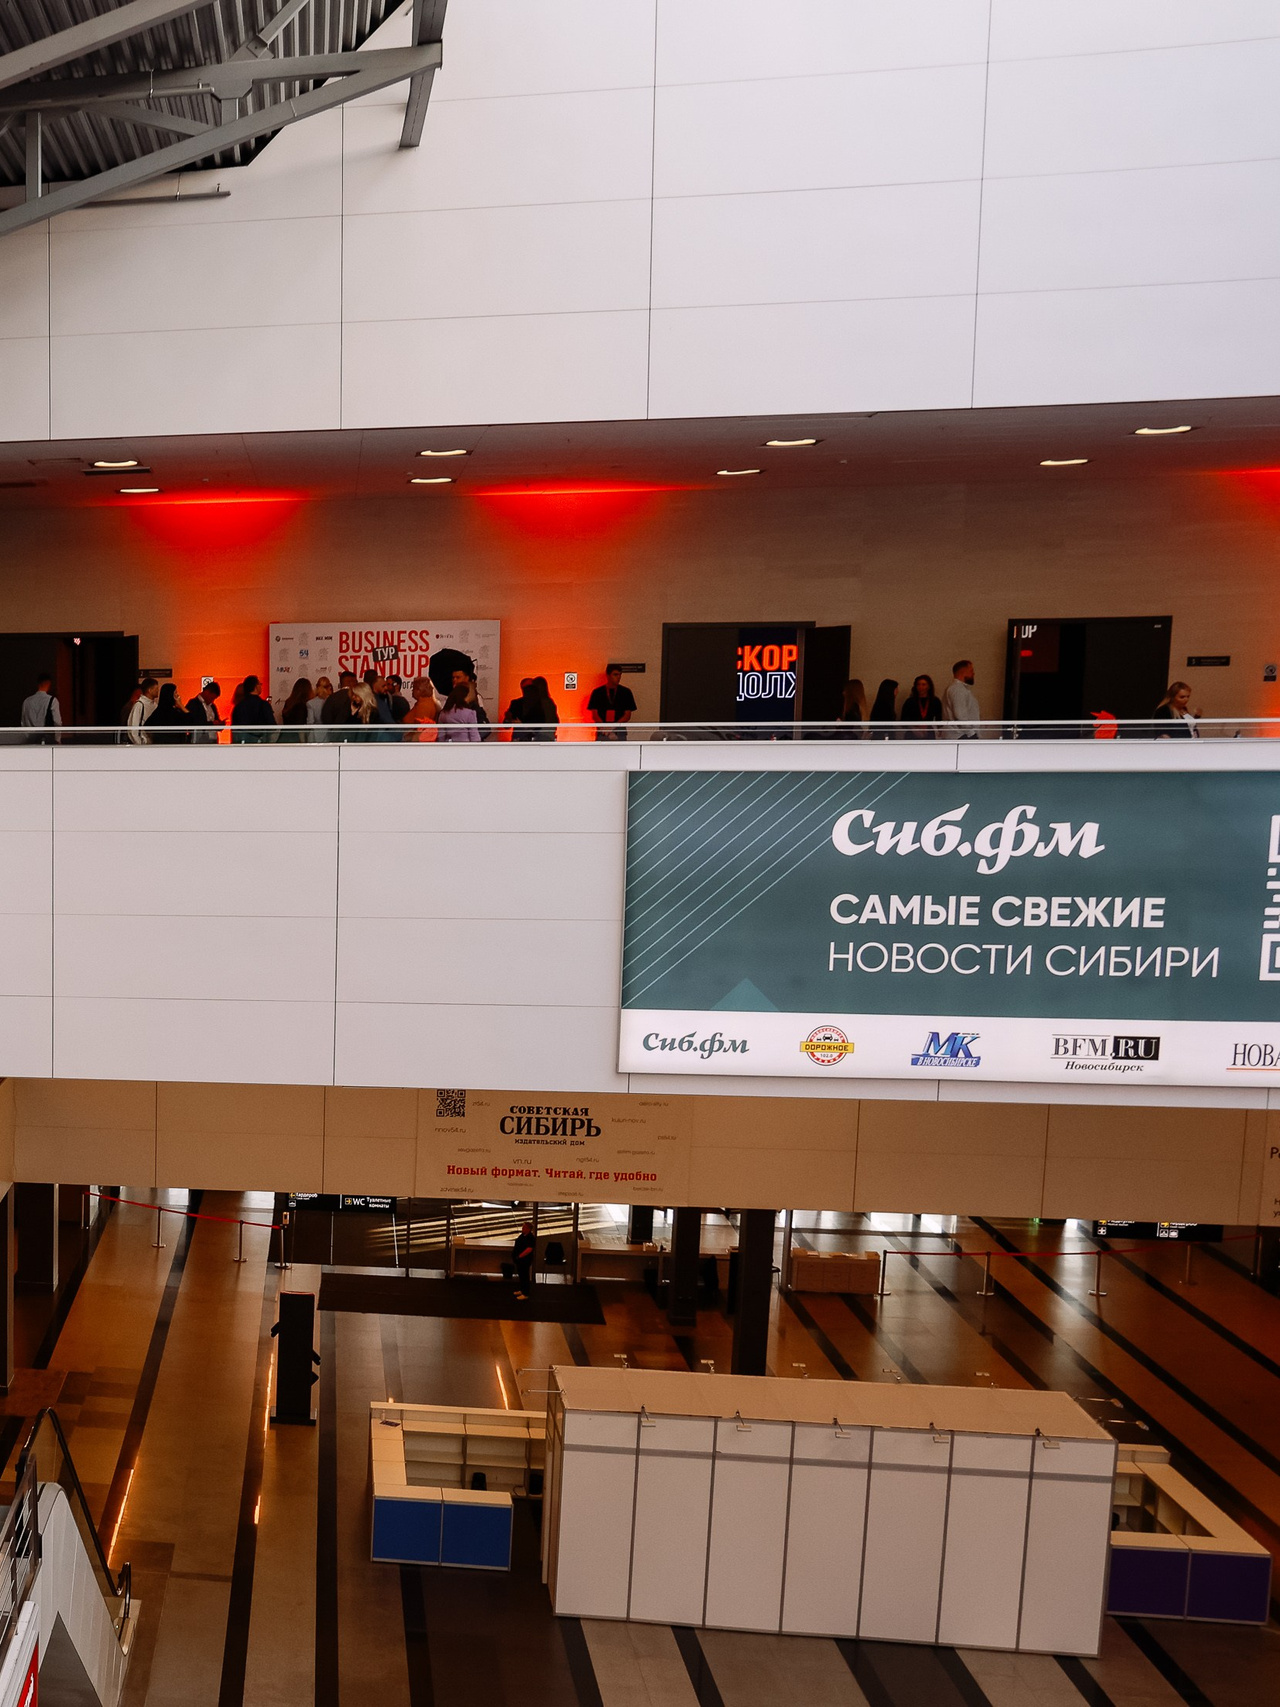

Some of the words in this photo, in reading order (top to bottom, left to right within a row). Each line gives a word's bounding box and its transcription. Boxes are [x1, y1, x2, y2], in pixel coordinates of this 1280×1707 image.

[338, 630, 430, 654] BUSINESS
[375, 646, 396, 662] ТУР
[338, 654, 430, 679] STANDUP
[831, 803, 1105, 875] Сиб.фм
[829, 893, 981, 926] САМЫЕ
[991, 895, 1166, 929] СВЕЖИЕ
[828, 941, 1032, 975] НОВОСТИ
[1044, 944, 1220, 978] СИБИРИ
[642, 1030, 751, 1060] Сиб.фм
[922, 1032, 981, 1058] МК
[1053, 1037, 1158, 1059] BFM.RU
[923, 1057, 978, 1067] НОВОСИБИРСКЕ
[1065, 1061, 1144, 1073] Новосибирск
[509, 1105, 590, 1117] СОВЕТСКАЯ
[499, 1116, 602, 1138] СИБИРЬ
[514, 1138, 567, 1146] издательский
[569, 1139, 585, 1147] дом
[446, 1164, 487, 1176] Новый
[491, 1165, 541, 1179] формат.
[545, 1167, 587, 1180] Читай,
[588, 1170, 610, 1181] где
[613, 1170, 658, 1183] удобно
[353, 1198, 365, 1206] WC
